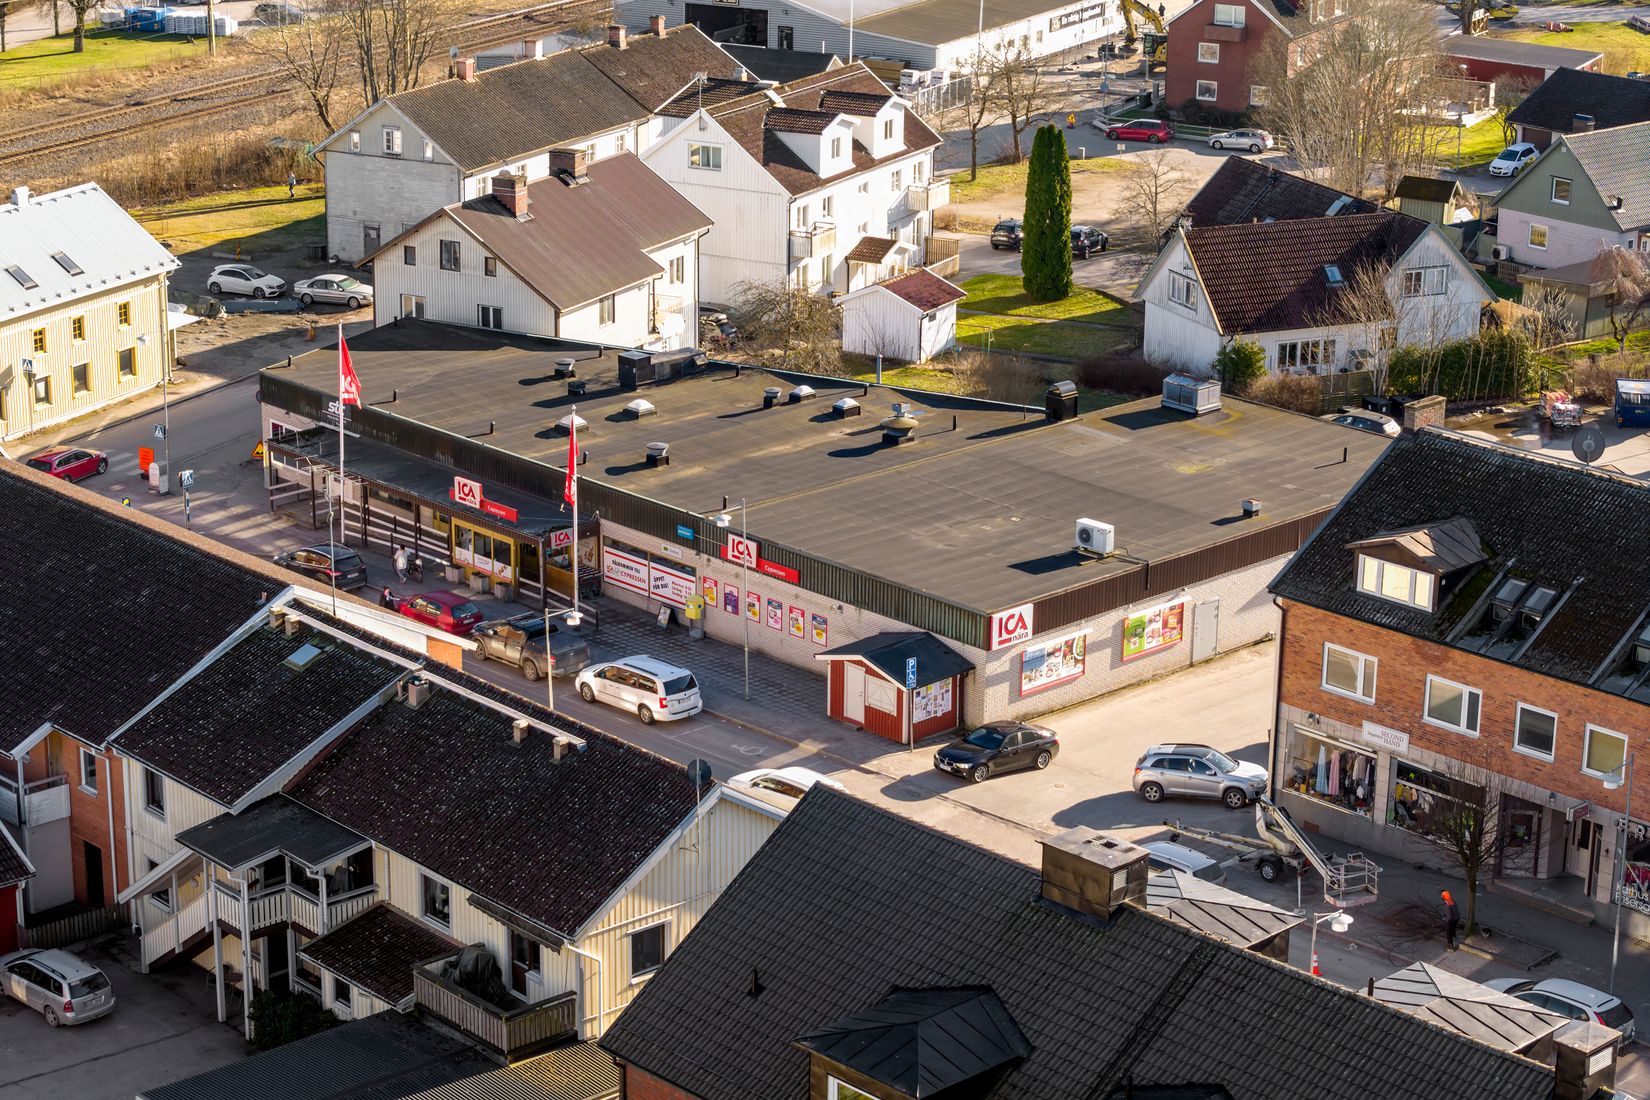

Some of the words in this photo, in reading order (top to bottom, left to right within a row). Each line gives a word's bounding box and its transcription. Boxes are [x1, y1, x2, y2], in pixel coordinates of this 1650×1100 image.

[458, 481, 476, 500] ICA
[554, 531, 571, 544] ICA
[731, 538, 753, 559] ICA
[765, 565, 786, 576] Cypressen
[998, 611, 1028, 638] ICA
[1012, 631, 1029, 642] nära
[909, 660, 915, 669] P
[1382, 731, 1404, 742] SECOND
[1384, 738, 1401, 747] HAND
